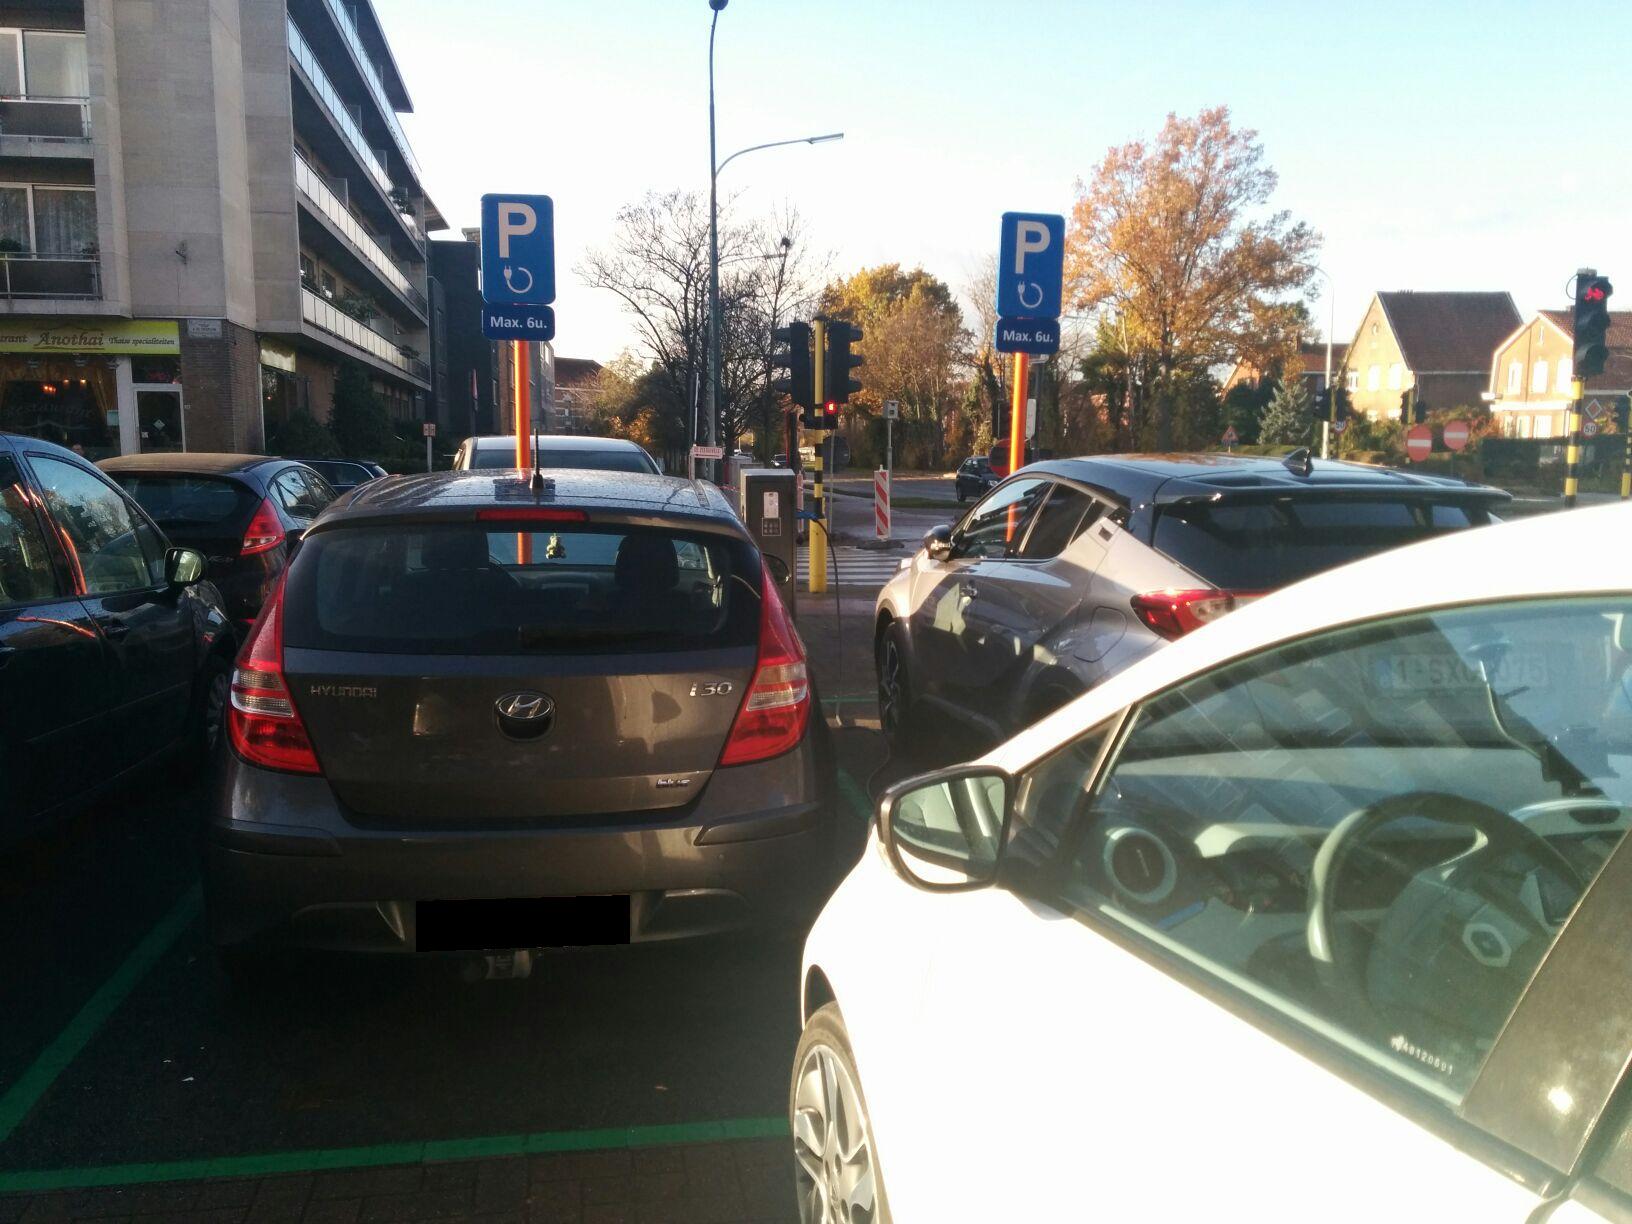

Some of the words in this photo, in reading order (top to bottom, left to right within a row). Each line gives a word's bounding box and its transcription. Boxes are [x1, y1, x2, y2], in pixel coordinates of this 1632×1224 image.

[497, 202, 537, 258] P
[1015, 219, 1051, 274] P
[490, 316, 523, 329] Max.
[526, 317, 548, 330] 6u.
[34, 331, 104, 347] Anothai
[1003, 329, 1032, 342] Max.
[1035, 330, 1054, 343] 6u.
[310, 685, 377, 698] HYUNDAI
[689, 681, 733, 697] i30
